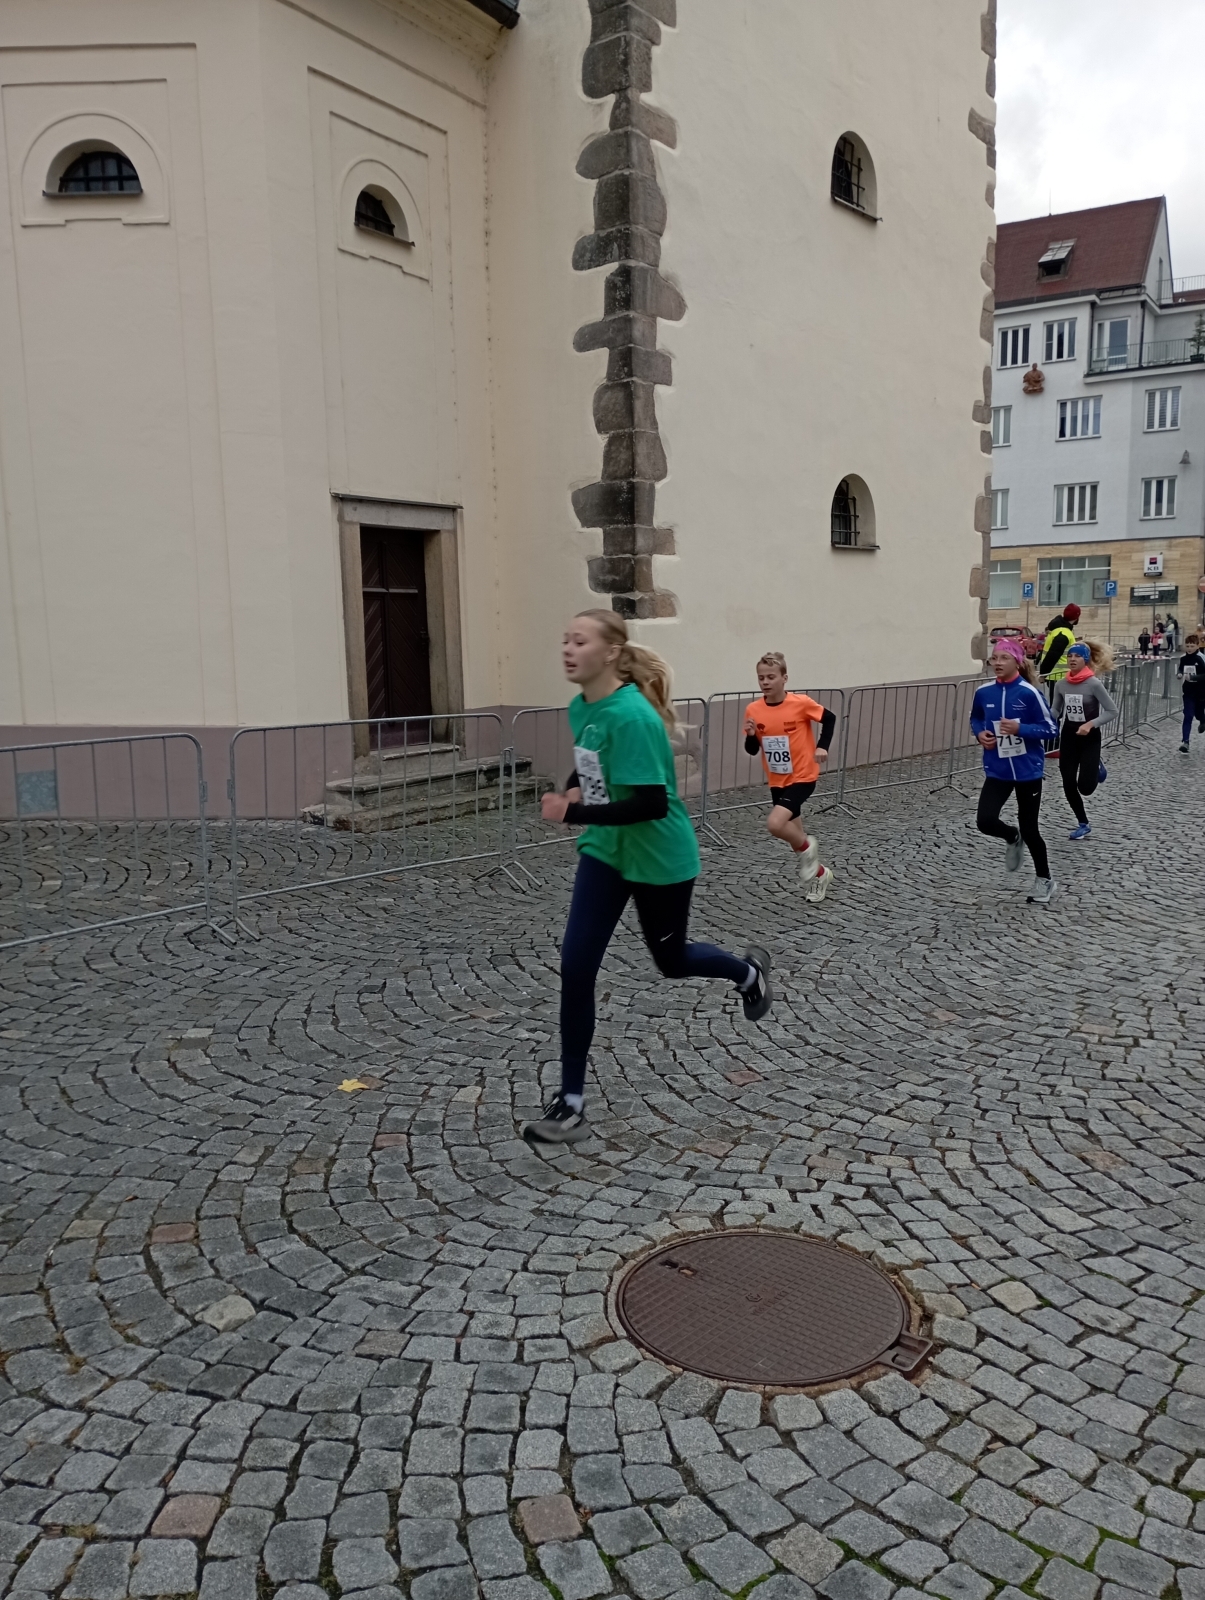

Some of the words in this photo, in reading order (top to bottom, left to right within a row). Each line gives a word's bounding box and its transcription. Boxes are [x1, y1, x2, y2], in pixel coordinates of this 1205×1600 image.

[1024, 583, 1032, 594] P
[1107, 582, 1115, 592] P
[1066, 704, 1084, 714] 933
[765, 750, 791, 763] 708
